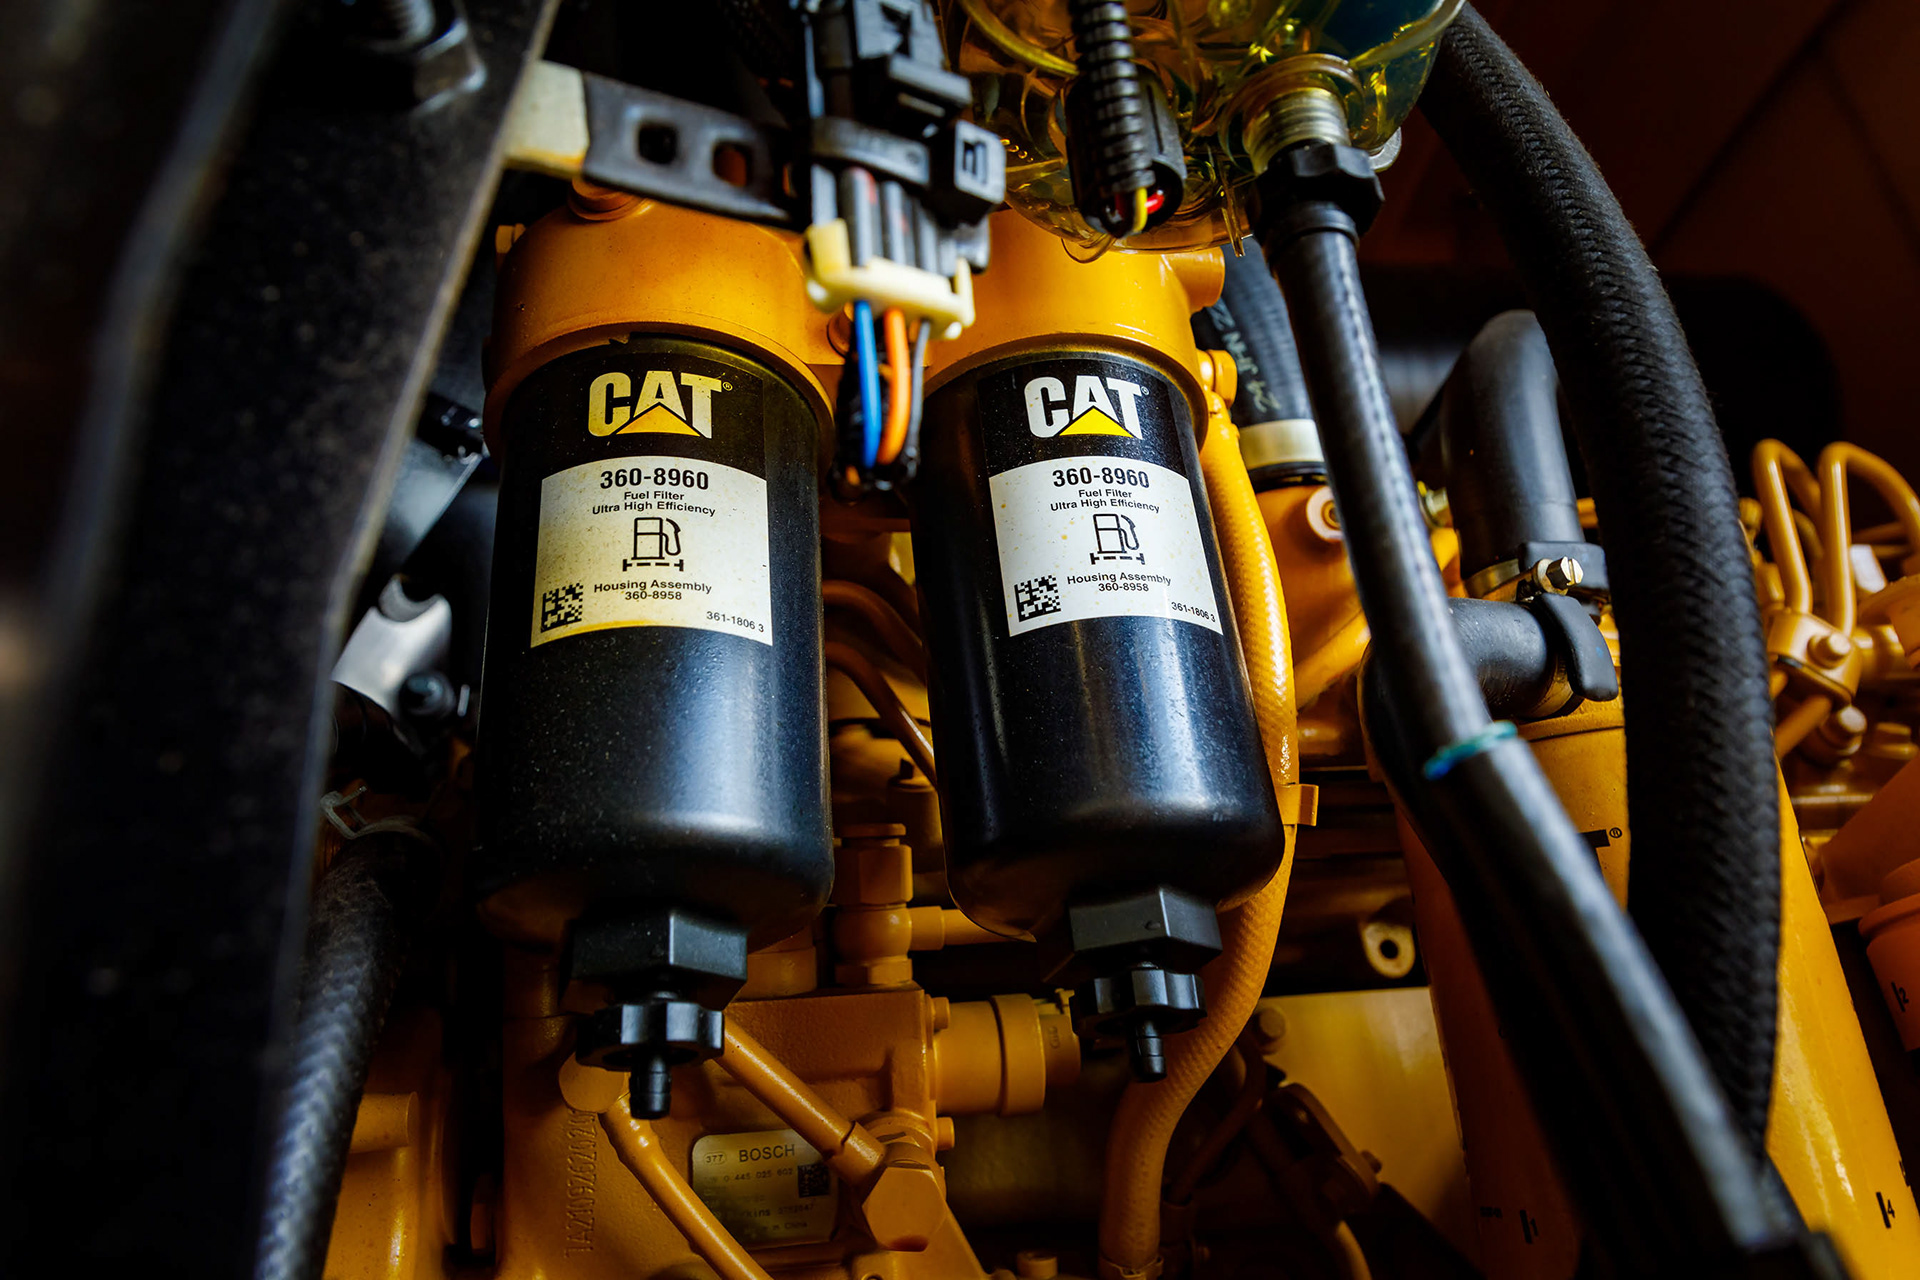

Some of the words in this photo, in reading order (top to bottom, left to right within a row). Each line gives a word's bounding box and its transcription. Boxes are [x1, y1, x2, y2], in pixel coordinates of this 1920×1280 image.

[600, 468, 709, 490] 360-8960
[1052, 467, 1150, 488] 360-8960
[624, 491, 650, 500] Fuel
[653, 491, 685, 500] Filter
[1079, 489, 1102, 498] Fuel
[1105, 489, 1132, 498] Filter
[592, 503, 620, 515] Ultra
[624, 501, 653, 511] High
[657, 501, 716, 517] Efficiency
[1050, 502, 1078, 511] Ultra
[1081, 499, 1107, 509] High
[1111, 499, 1160, 513] Efficiency
[1067, 572, 1117, 585] Housing
[1120, 572, 1171, 586] Assembly
[594, 580, 647, 593] Housing
[651, 580, 712, 594] Assembly
[1098, 583, 1150, 592] 360-8958
[625, 591, 682, 600] 360-8958
[1171, 601, 1210, 620] 361-1806
[1210, 613, 1216, 622] 3
[706, 611, 756, 630] 361-1806
[758, 623, 765, 633] 3
[706, 1154, 724, 1163] 377
[739, 1144, 795, 1162] BOSCH
